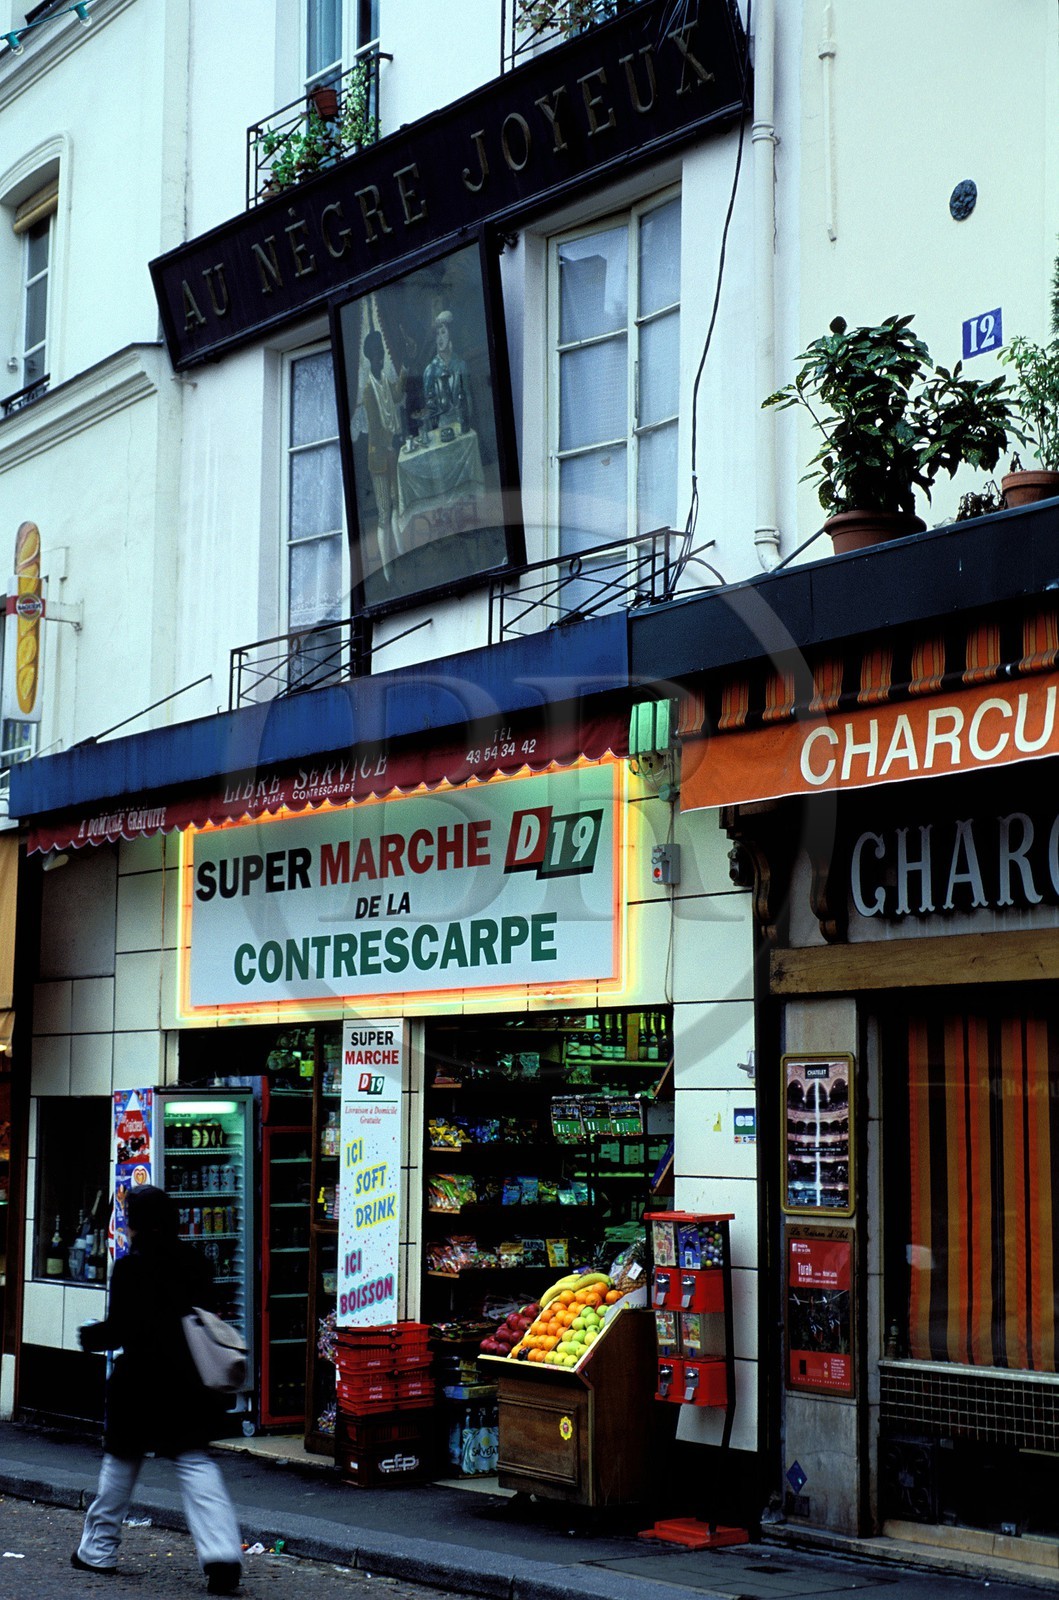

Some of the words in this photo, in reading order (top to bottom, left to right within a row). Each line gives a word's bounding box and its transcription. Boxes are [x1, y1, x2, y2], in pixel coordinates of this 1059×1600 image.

[178, 262, 232, 334] AU
[462, 18, 716, 193] JOYEUX
[970, 314, 995, 353] 12
[493, 727, 512, 743] TEL
[799, 686, 1058, 786] CHARCU
[465, 749, 481, 764] 43
[484, 745, 498, 761] 54
[501, 742, 516, 758] 34
[521, 738, 537, 754] 42
[223, 774, 281, 804] LIBRE
[293, 752, 389, 791] SERVICE
[248, 800, 259, 808] LA
[263, 792, 285, 805] PLACE
[292, 783, 355, 800] CONTRESCARPE
[127, 807, 167, 830] GRATUITE
[196, 847, 313, 902] SUPER
[319, 820, 492, 886] MARCHE
[514, 813, 595, 867] D19
[851, 812, 1059, 918] CHAR
[355, 895, 381, 920] DE
[385, 891, 412, 917] LA
[234, 912, 558, 986] CONTRESCARPE
[350, 1030, 394, 1047] SUPER
[344, 1049, 400, 1066] MARCHE
[359, 1073, 384, 1094] D19
[346, 1143, 363, 1167] ICI
[355, 1164, 387, 1194] SOFT
[355, 1196, 396, 1228] DRINK
[344, 1251, 362, 1277] ICI
[340, 1275, 394, 1315] BOISSON
